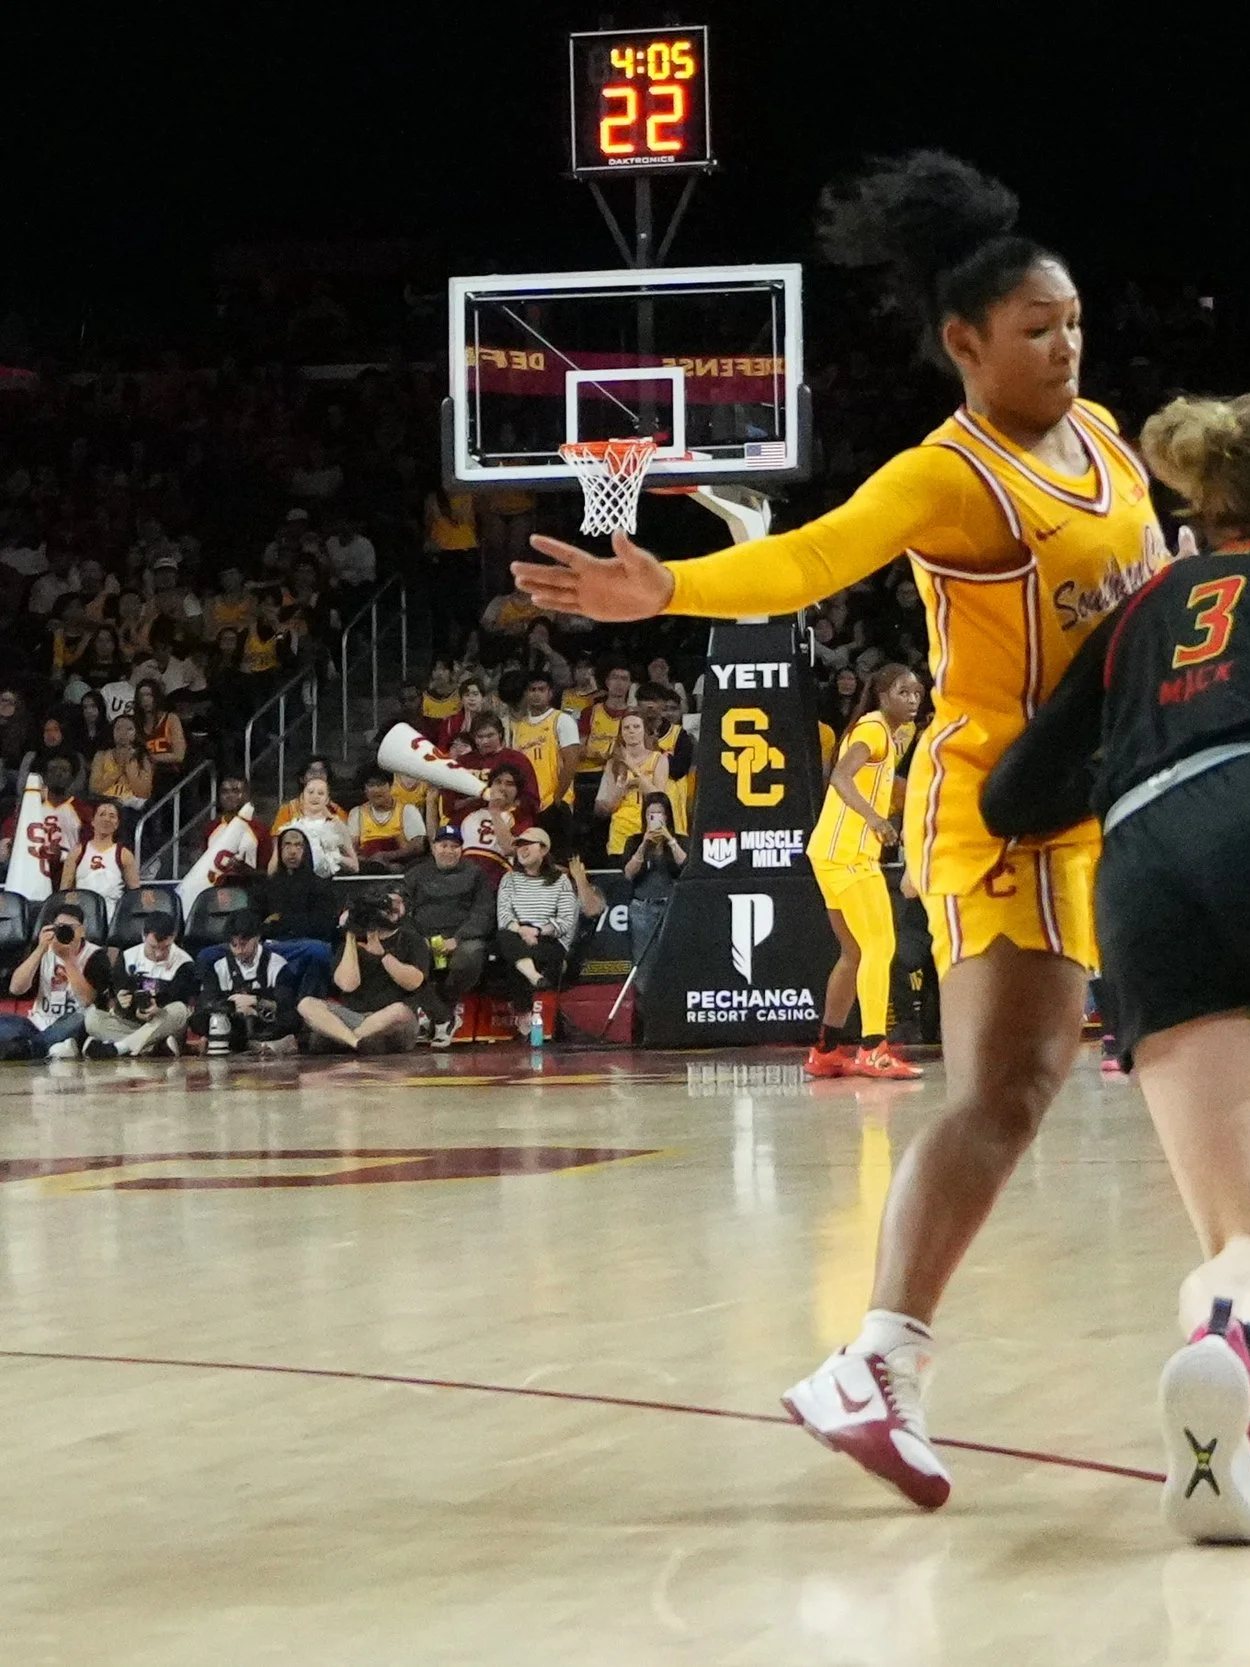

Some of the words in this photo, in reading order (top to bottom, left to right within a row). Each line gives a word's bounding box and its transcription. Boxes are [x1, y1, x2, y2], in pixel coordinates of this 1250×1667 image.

[610, 41, 695, 80] 4:05
[600, 85, 684, 153] 22
[608, 155, 675, 166] DAKTRONICS
[1171, 574, 1247, 670] 3
[710, 662, 790, 690] YETI
[720, 707, 786, 807] SC
[740, 829, 803, 850] MUSCLE
[752, 848, 791, 868] MILK
[686, 988, 814, 1009] PECHANGA
[686, 1010, 748, 1023] RESORT
[756, 1008, 818, 1022] CASINO
